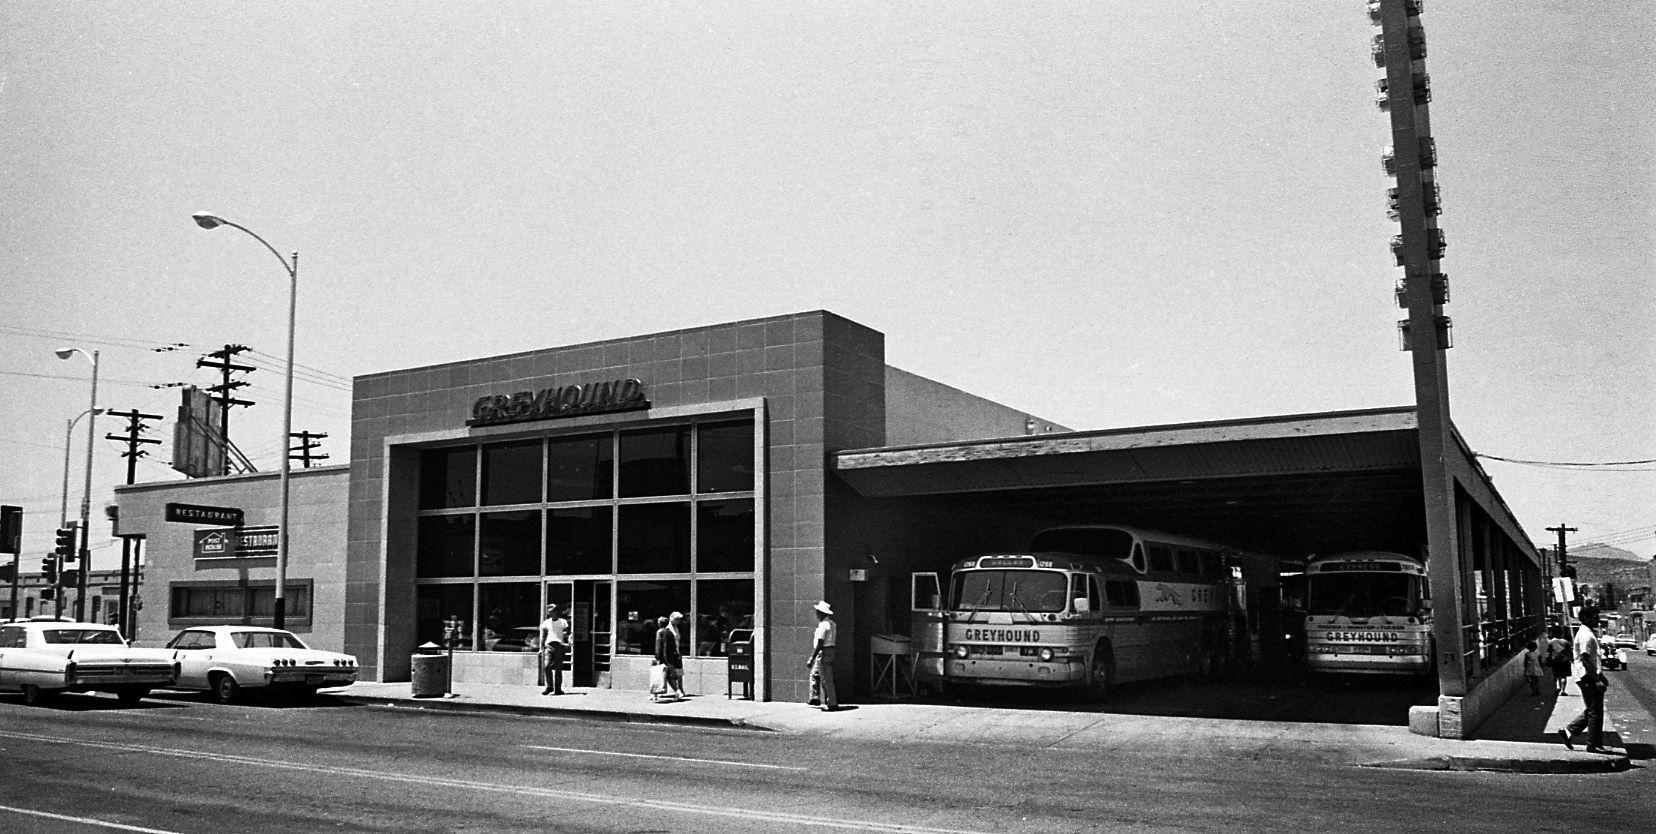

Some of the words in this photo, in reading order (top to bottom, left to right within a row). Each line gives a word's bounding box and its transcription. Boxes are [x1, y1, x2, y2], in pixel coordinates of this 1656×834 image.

[473, 378, 644, 419] GREYHOUND
[175, 508, 238, 520] RESTAURANT
[965, 629, 1041, 642] GREYHOUND
[1326, 631, 1398, 642] GREYHOUND
